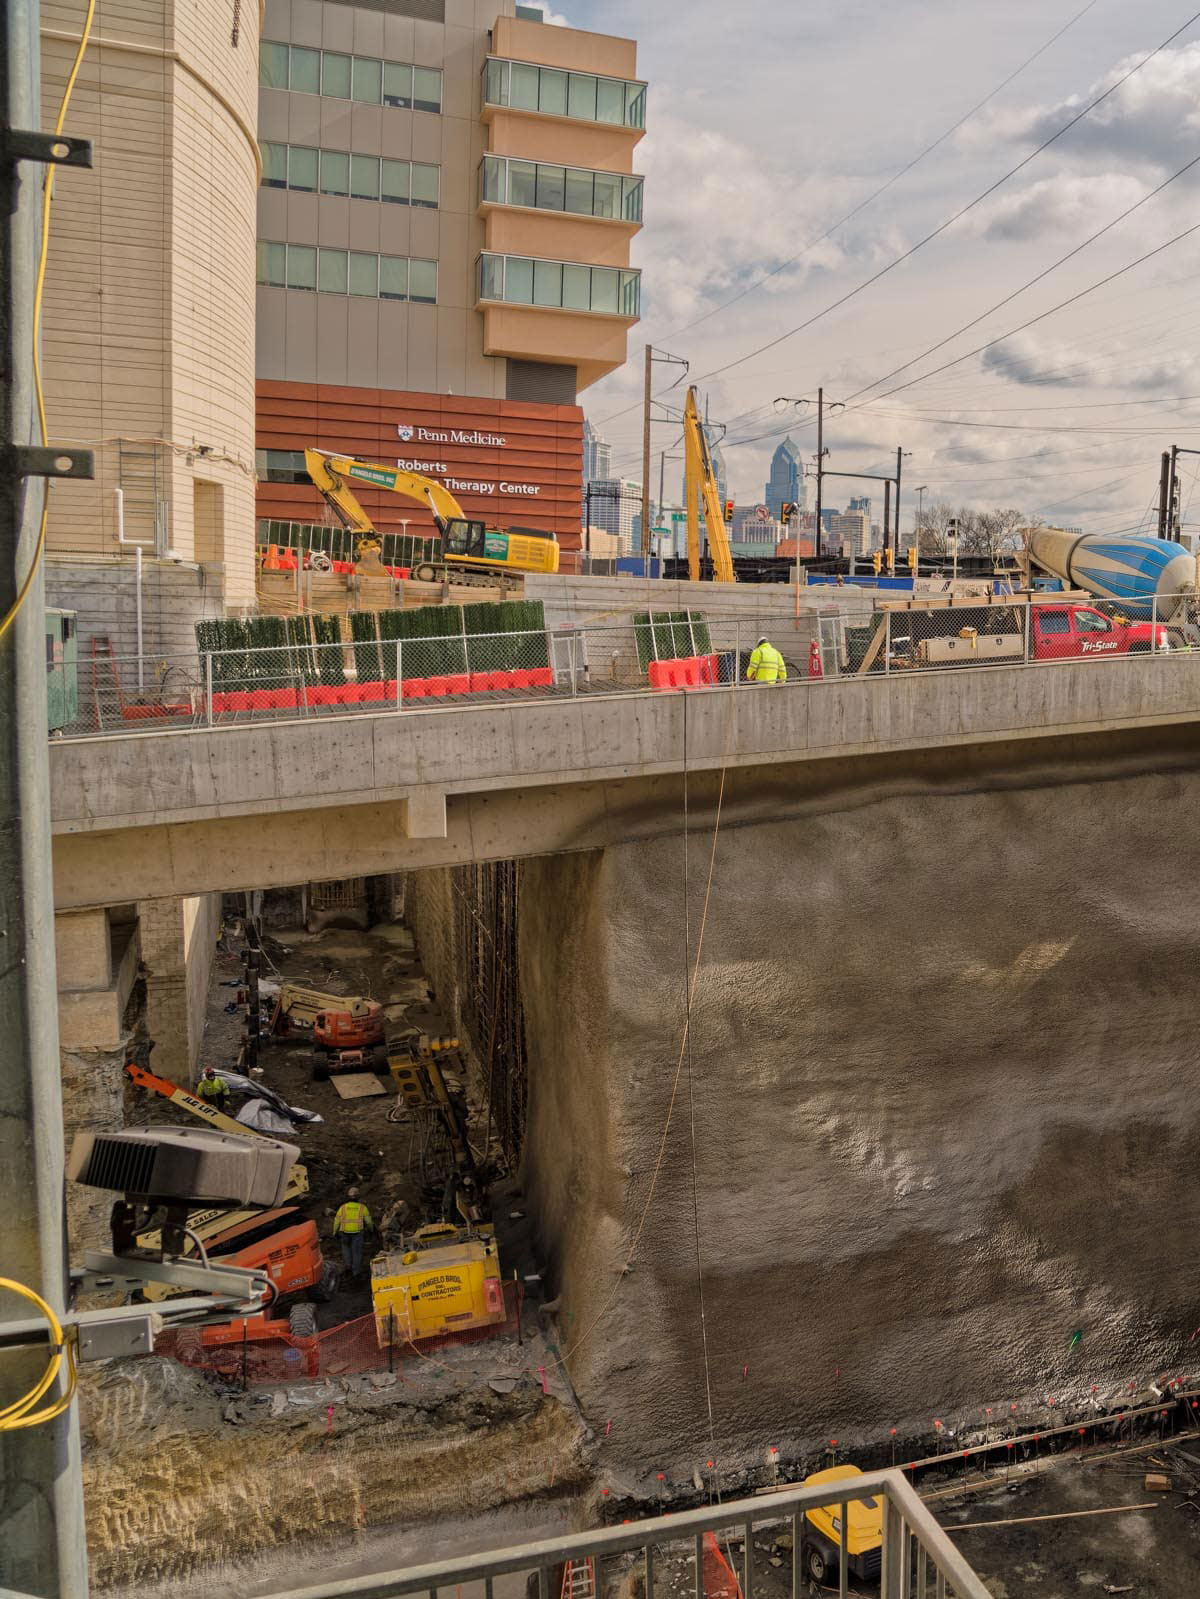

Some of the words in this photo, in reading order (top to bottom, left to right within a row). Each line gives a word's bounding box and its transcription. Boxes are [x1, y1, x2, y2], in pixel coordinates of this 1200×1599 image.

[418, 427, 448, 442] Penn
[450, 430, 506, 446] Medicine
[397, 459, 447, 473] Roberts
[443, 478, 495, 494] Therapy
[499, 482, 540, 495] Center
[1081, 640, 1118, 653] Tri-State
[182, 1095, 200, 1109] JLG
[198, 1102, 220, 1118] LIFT
[193, 1209, 219, 1227] SALES
[420, 1286, 462, 1298] CONTRACTORS
